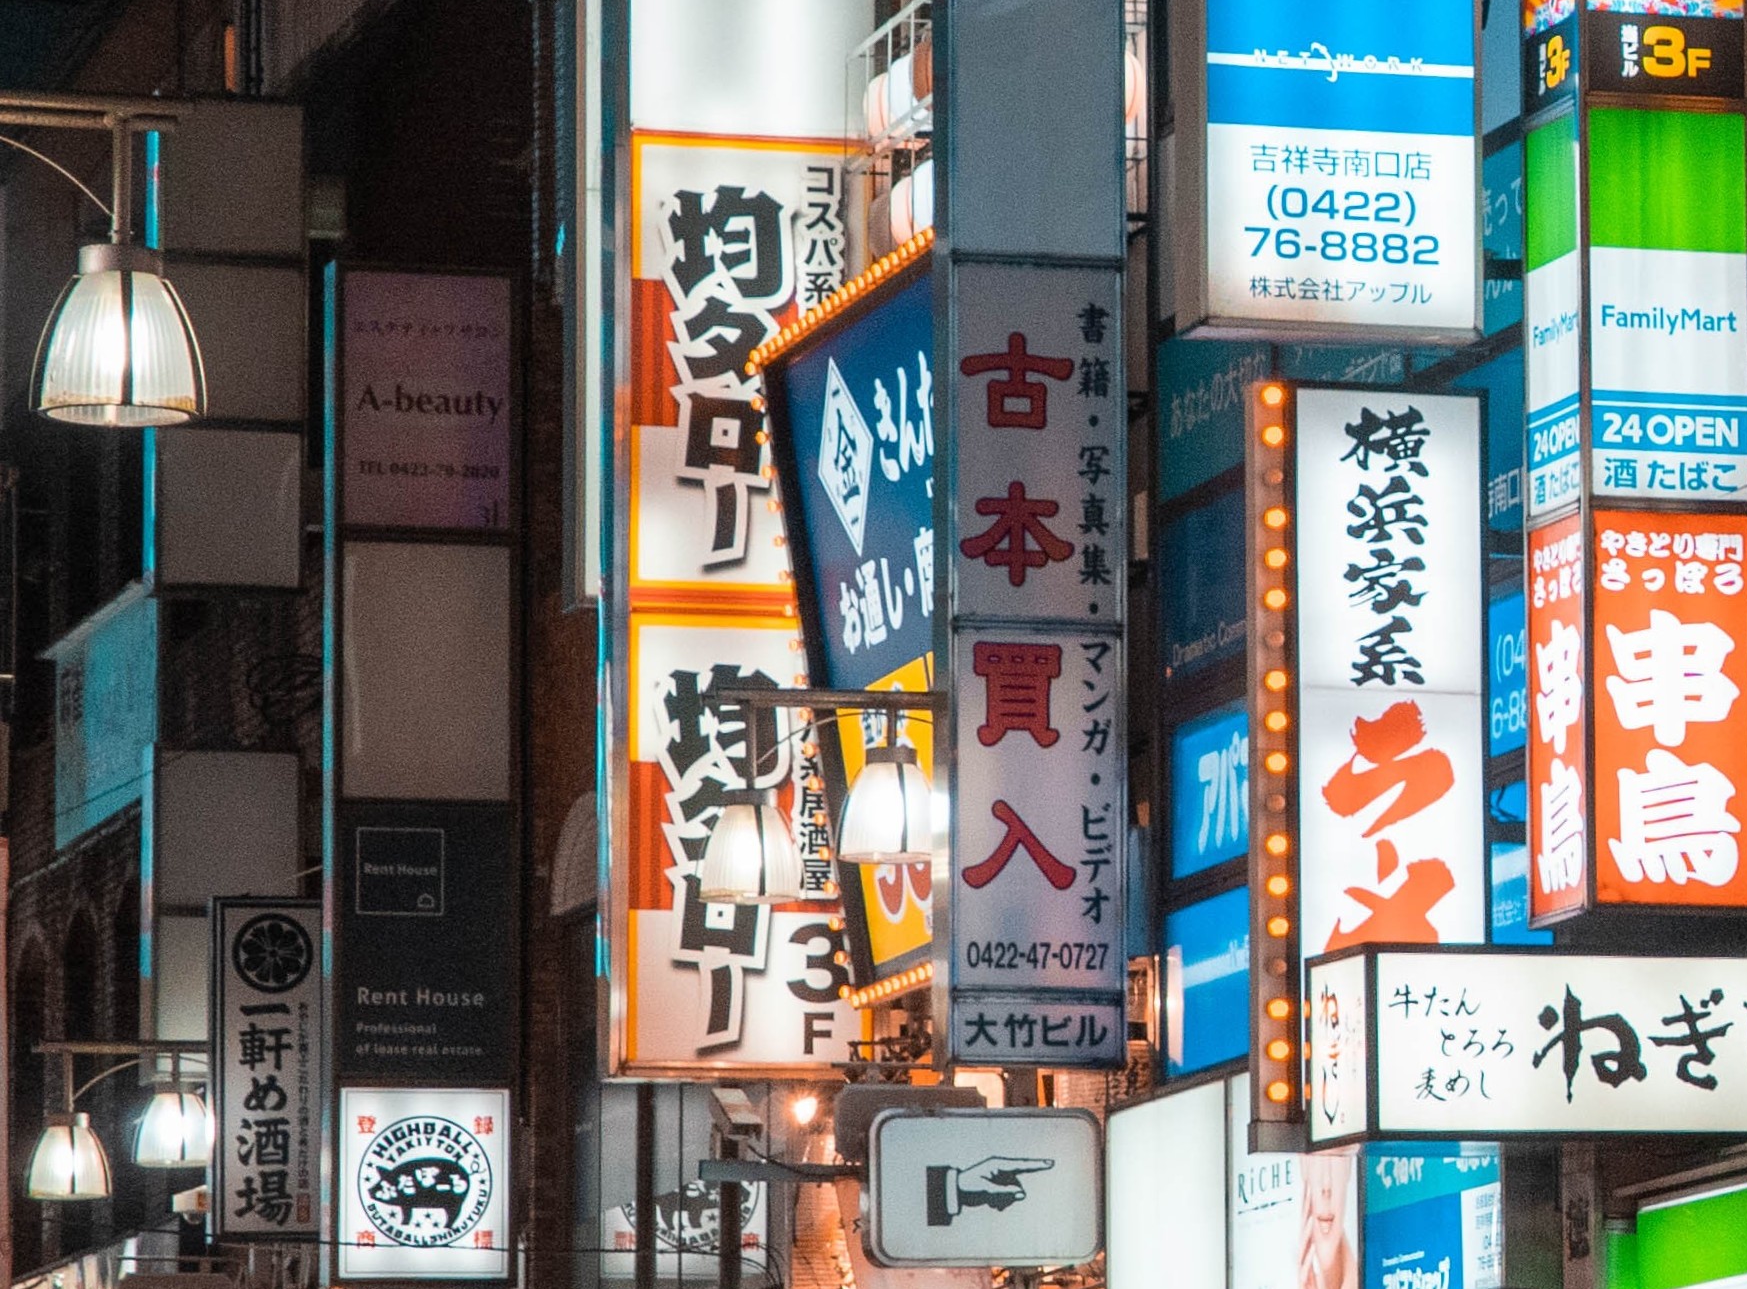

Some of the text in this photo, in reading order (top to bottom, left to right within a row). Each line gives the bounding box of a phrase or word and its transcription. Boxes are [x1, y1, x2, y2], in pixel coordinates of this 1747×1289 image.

[1643, 27, 1713, 79] 3F
[1250, 142, 1433, 182] 吉祥寺南口店
[1265, 184, 1417, 228] (0422)
[1244, 226, 1441, 268] 76-8882
[1249, 276, 1433, 307] 株式会社アップル
[1601, 305, 1738, 337] FamilyMart
[358, 383, 500, 425] A-beauty
[1602, 413, 1740, 449] 24 OPEN
[1604, 457, 1739, 494] 酒 たばこ
[1339, 405, 1433, 687] 横浜家系
[1600, 529, 1745, 564] やきとり専門
[1600, 560, 1745, 597] さっぽろ
[1536, 617, 1585, 894] 串鳥
[1604, 607, 1742, 890] 串鳥
[966, 940, 1110, 971] 0422-47-0727
[357, 986, 485, 1008] Rent House
[1388, 983, 1482, 1019] 牛たん
[964, 1012, 1109, 1050] 大竹ビル
[1439, 1027, 1515, 1059] とろろ
[1414, 1066, 1492, 1102] 麦めし
[233, 1002, 294, 1228] 一軒め酒場
[372, 1121, 473, 1159] HIGHBALL
